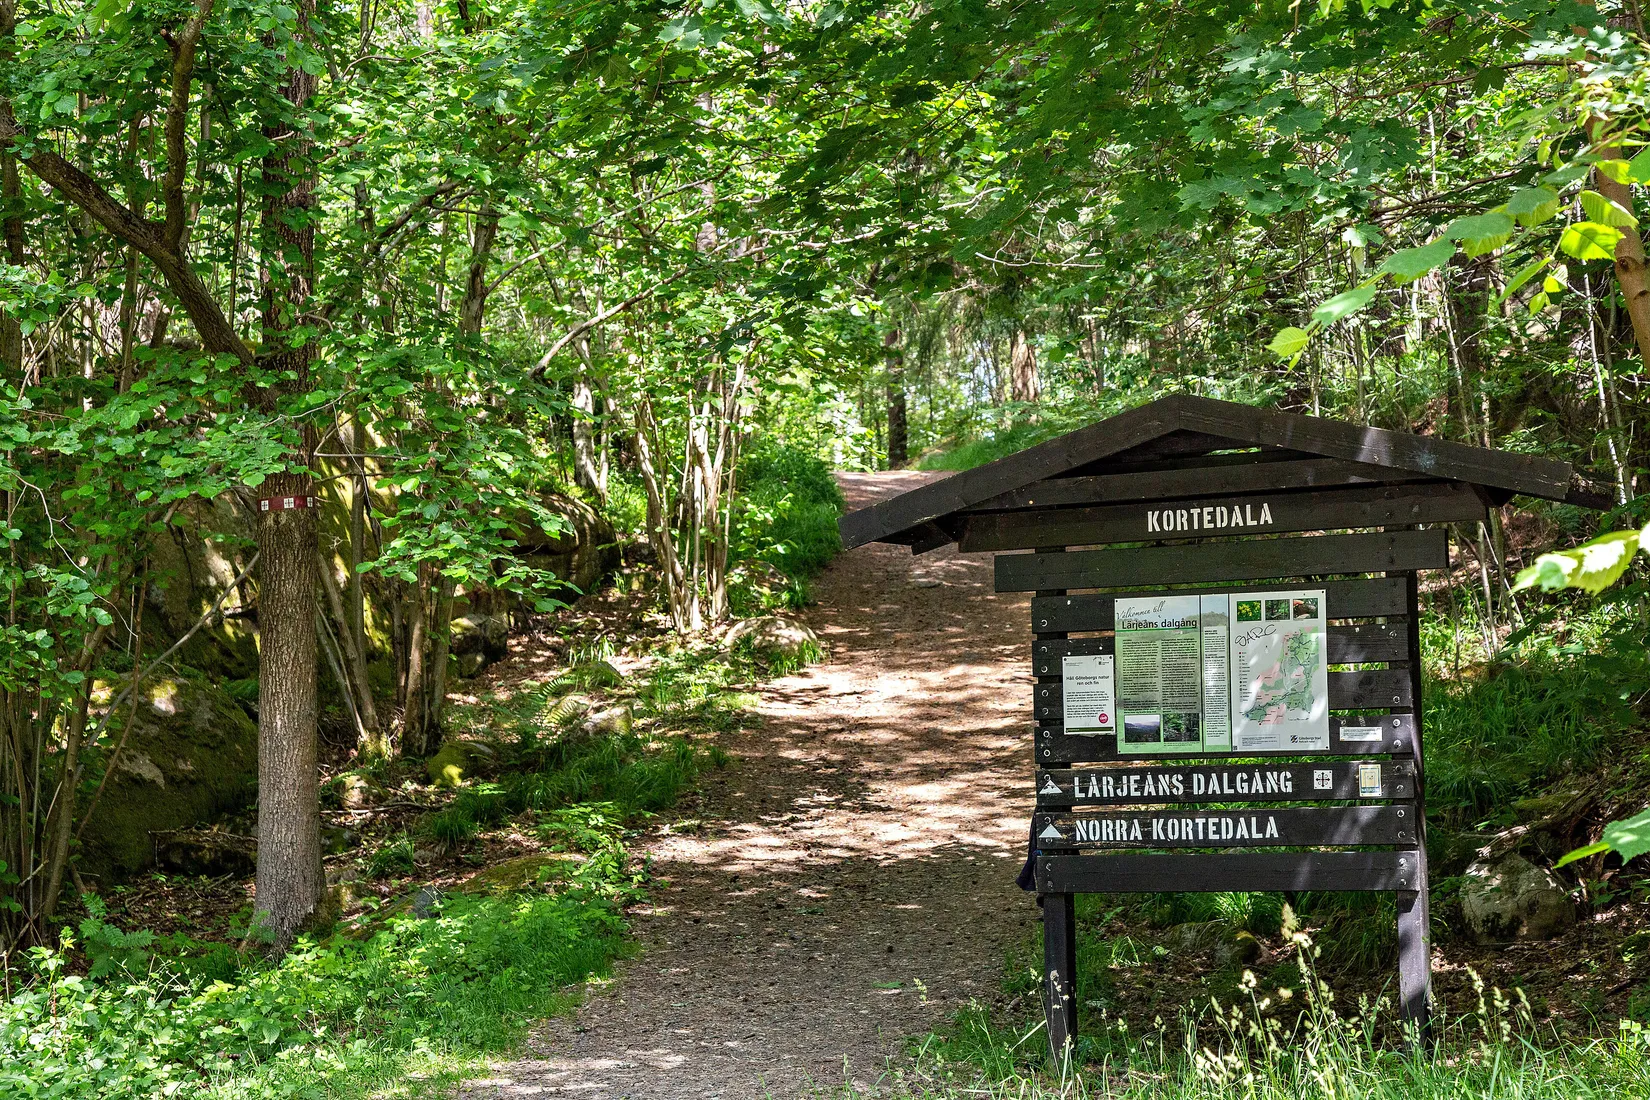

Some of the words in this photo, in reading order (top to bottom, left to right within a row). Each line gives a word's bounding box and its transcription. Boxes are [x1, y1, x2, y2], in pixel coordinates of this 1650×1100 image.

[1147, 503, 1273, 532] KORTEDALA
[1153, 600, 1166, 613] till
[1122, 619, 1158, 630] Lärjeåns
[1161, 618, 1197, 629] dalgång
[1074, 772, 1184, 798] LÄRJEÅNS
[1192, 769, 1293, 795] DALGÅNG
[1075, 818, 1143, 841] NORRA
[1152, 816, 1279, 840] KORTEDALA
